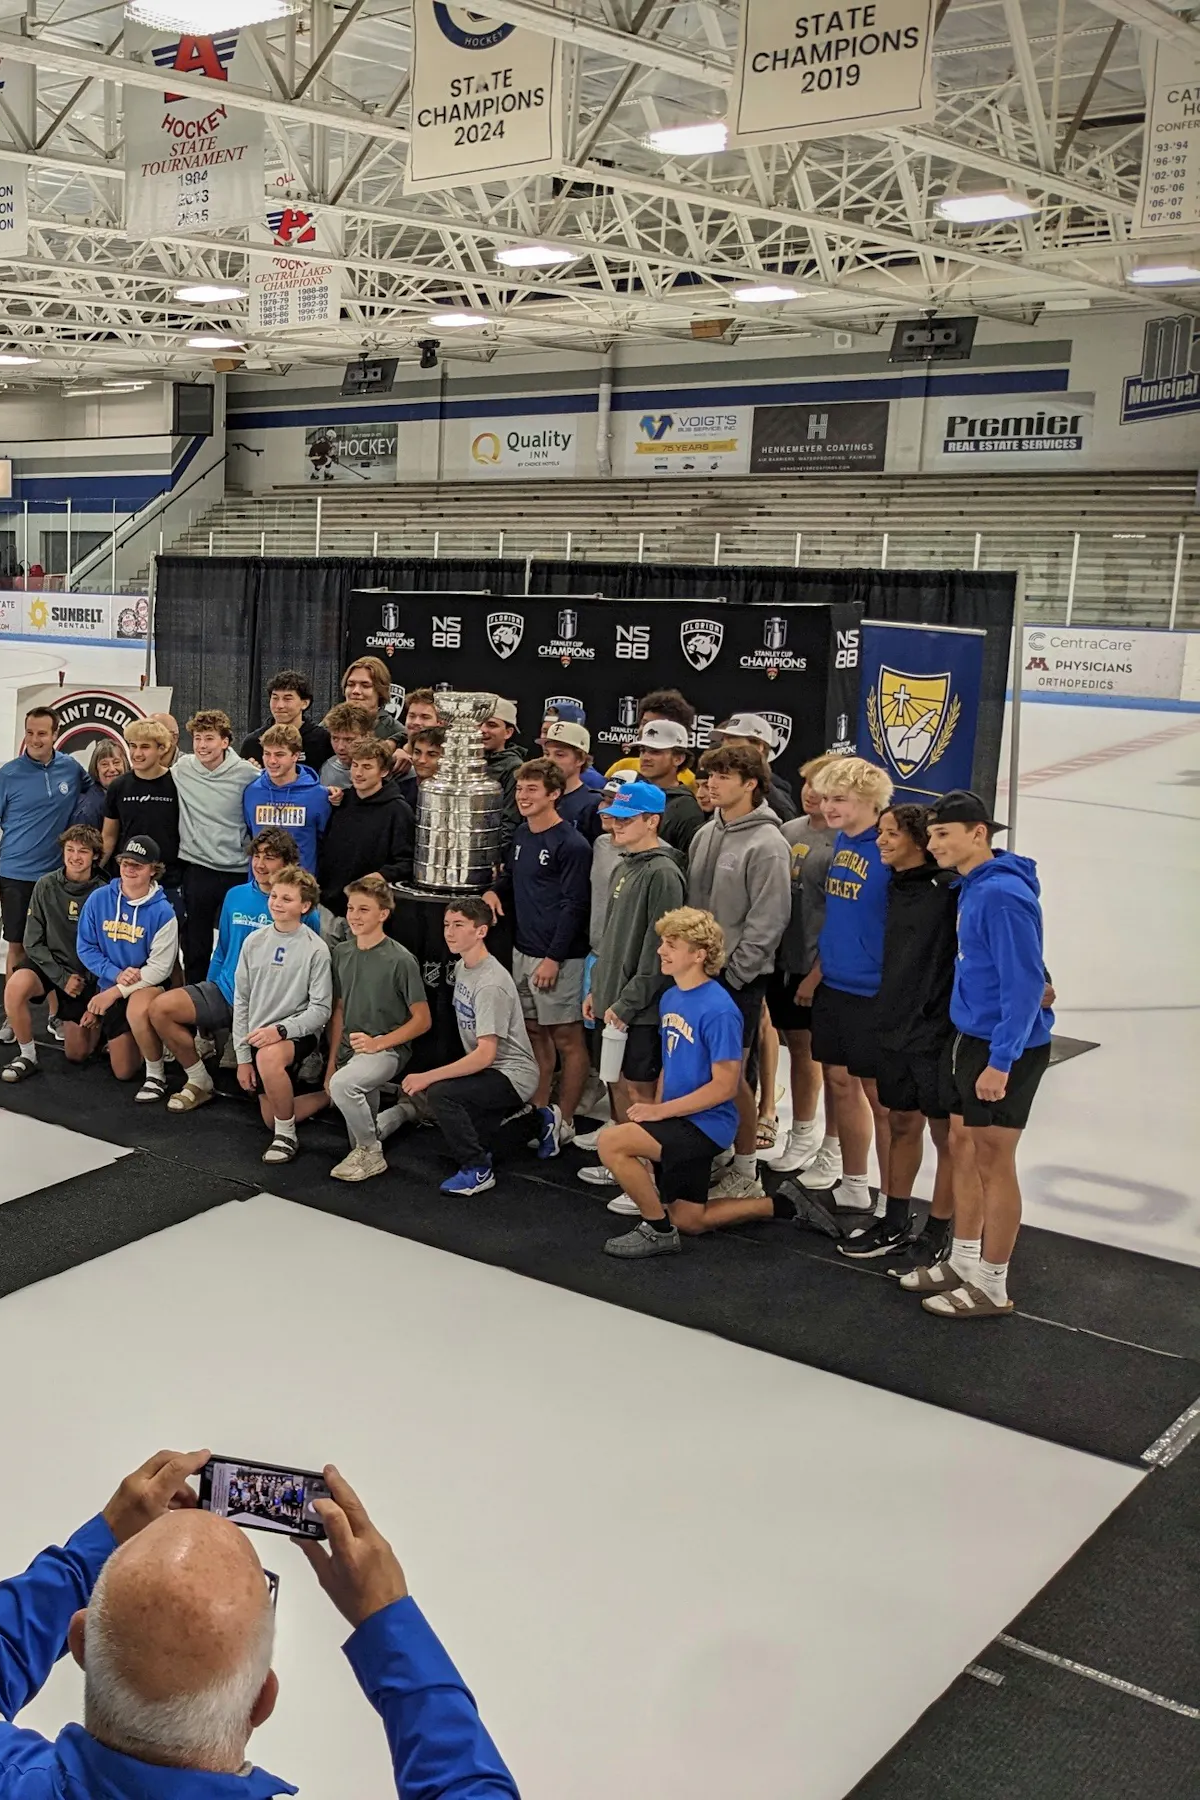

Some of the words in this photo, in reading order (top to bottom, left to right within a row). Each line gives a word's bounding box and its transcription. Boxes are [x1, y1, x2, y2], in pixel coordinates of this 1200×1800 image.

[795, 4, 876, 38] STATE
[464, 30, 503, 46] HOCKEY
[752, 26, 918, 73] CHAMPIONS
[450, 68, 512, 97] STATE
[801, 64, 860, 94] 2019
[418, 88, 544, 127] CHAMPIONS
[162, 104, 228, 138] HOCKEY
[454, 120, 505, 146] 2024
[170, 136, 218, 156] STATE
[1154, 140, 1188, 152] '93-'94
[141, 146, 248, 177] TOURNAMENT
[1154, 156, 1187, 166] '96-'97
[1152, 170, 1186, 180] '02-'03
[1151, 184, 1185, 194] '05-'06
[1150, 198, 1184, 208] '06-'07
[1148, 211, 1182, 222] '07-'08
[255, 269, 299, 284] CENTRAL
[302, 266, 332, 278] LAKES
[264, 276, 324, 292] CHAMPIONS
[260, 291, 289, 300] 1977-78
[298, 286, 328, 295] 1988-89
[298, 293, 328, 302] 1989-90
[260, 305, 289, 314] 1981-82
[298, 300, 328, 309] 1992-93
[298, 307, 328, 316] 1996-97
[298, 314, 328, 322] 1997-98
[1128, 374, 1199, 406] Municipal
[680, 415, 736, 426] VOIGT'S
[946, 412, 1083, 438] Premier
[339, 438, 396, 456] HOCKEY
[507, 430, 572, 451] Quality
[948, 441, 975, 451] REAL
[979, 440, 1019, 450] ESTATE
[1022, 438, 1076, 450] SERVICES
[530, 450, 548, 458] INN
[762, 445, 822, 454] HENKEMEYER
[826, 444, 874, 452] COATINGS
[52, 607, 102, 623] SUNBELT
[490, 614, 522, 625] FLORIDA
[432, 616, 462, 632] NS
[685, 622, 720, 633] FLORIDA
[432, 632, 460, 648] 88
[616, 625, 650, 642] NS
[836, 630, 860, 649] NS
[366, 637, 415, 647] CHAMPIONS
[1050, 636, 1132, 650] CentraCare
[538, 646, 596, 658] CHAMPIONS
[616, 643, 649, 660] 88
[835, 650, 858, 668] 88
[740, 656, 806, 669] CHAMPIONS
[1056, 661, 1133, 673] PHYSICIANS
[1038, 677, 1114, 689] ORTHOPEDICS
[68, 901, 78, 915] C
[274, 946, 286, 963] C
